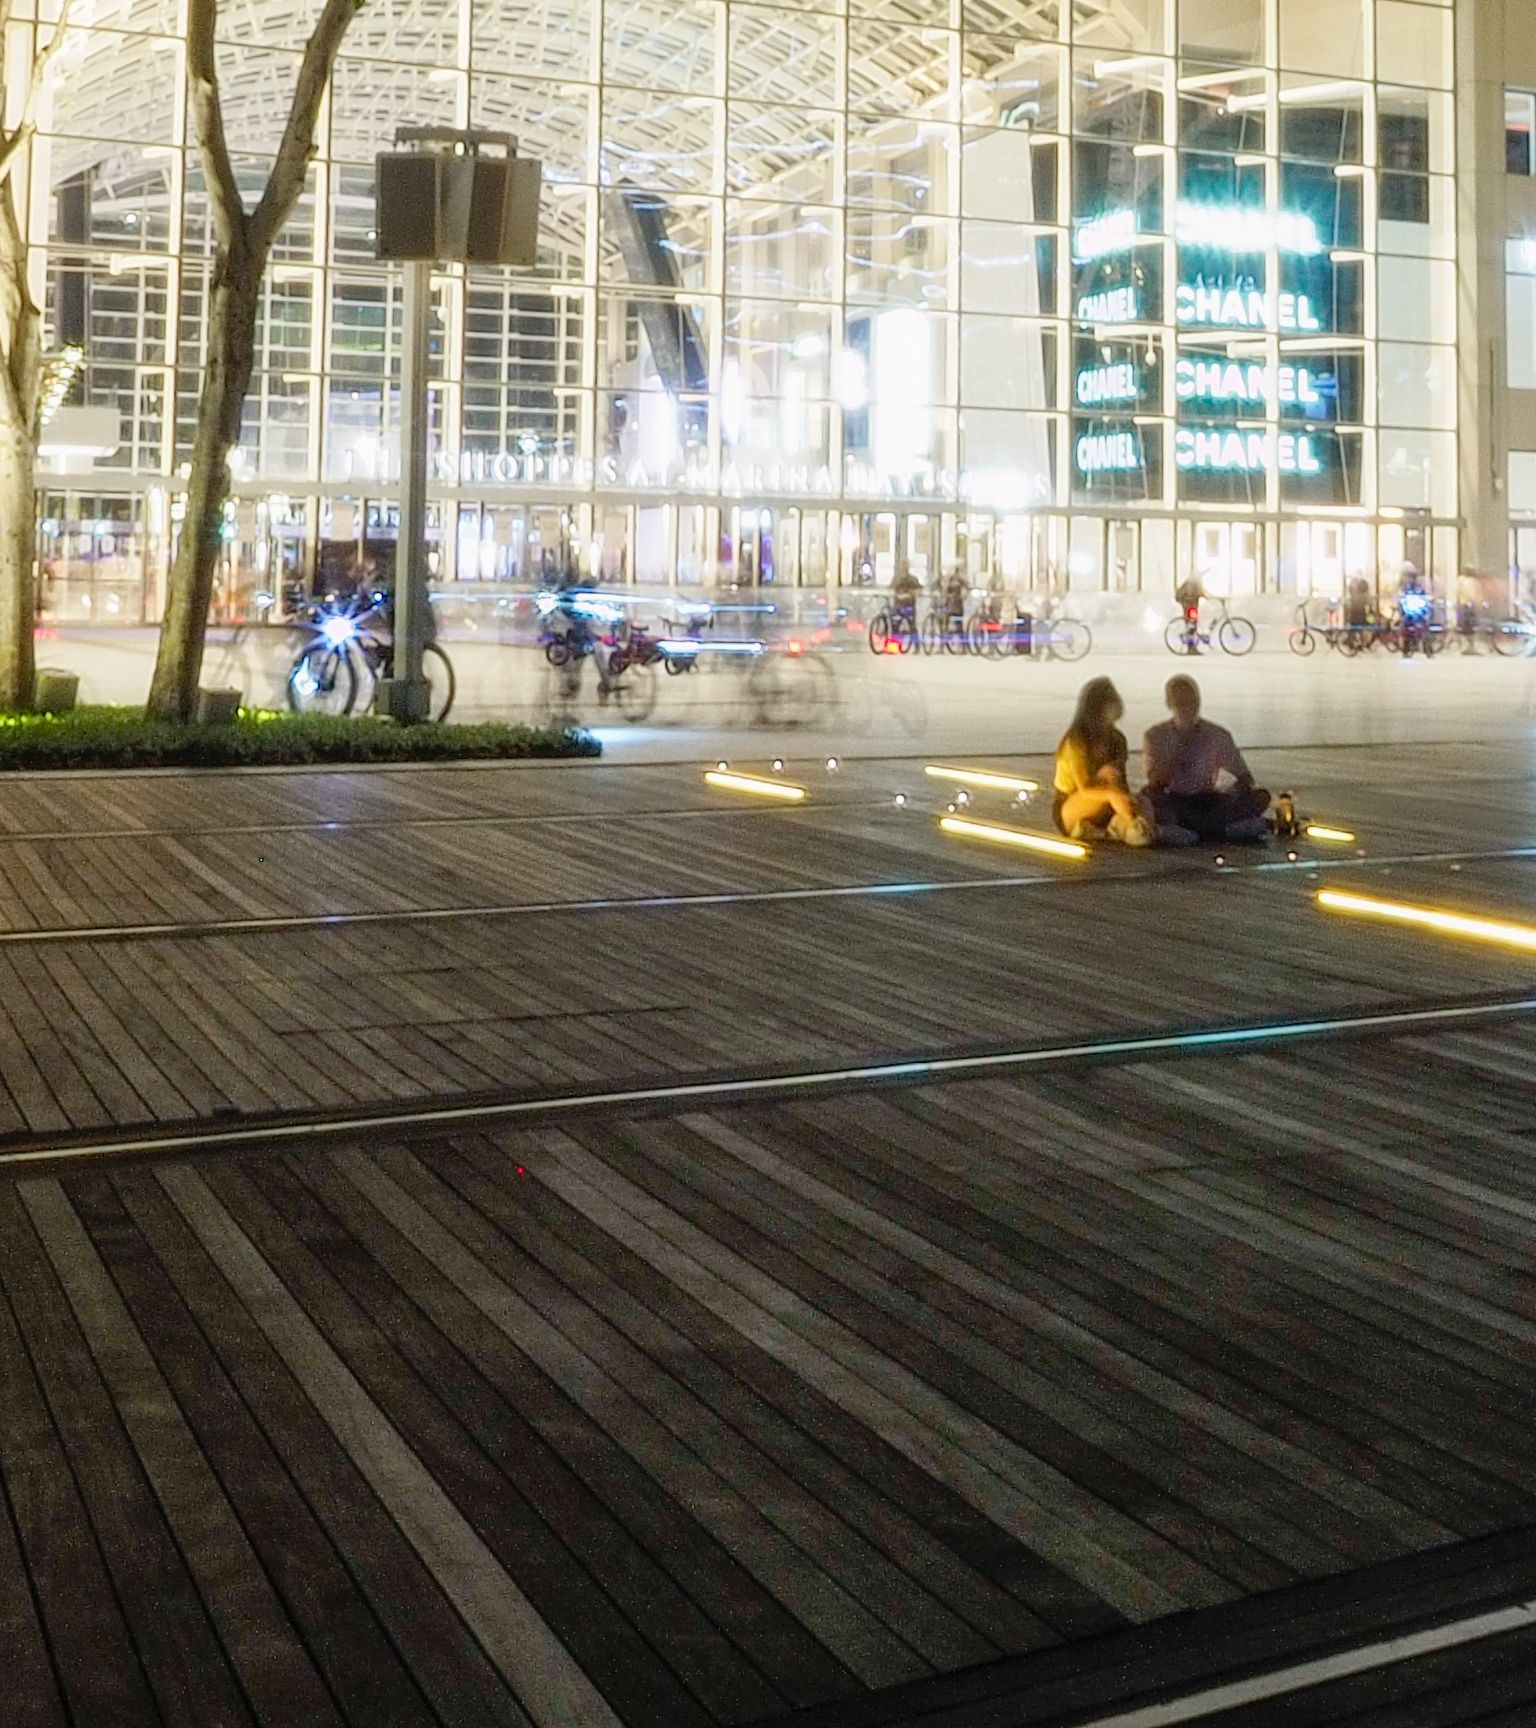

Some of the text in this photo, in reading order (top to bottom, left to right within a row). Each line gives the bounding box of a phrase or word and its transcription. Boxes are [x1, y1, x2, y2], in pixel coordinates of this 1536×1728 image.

[1077, 286, 1138, 322] CHANEL
[1176, 286, 1319, 329] CHANEL
[1077, 364, 1137, 403] CHANEL
[1176, 361, 1319, 402] CHANEL
[1077, 432, 1138, 472] CHANEL
[1176, 431, 1319, 471] CHANEL
